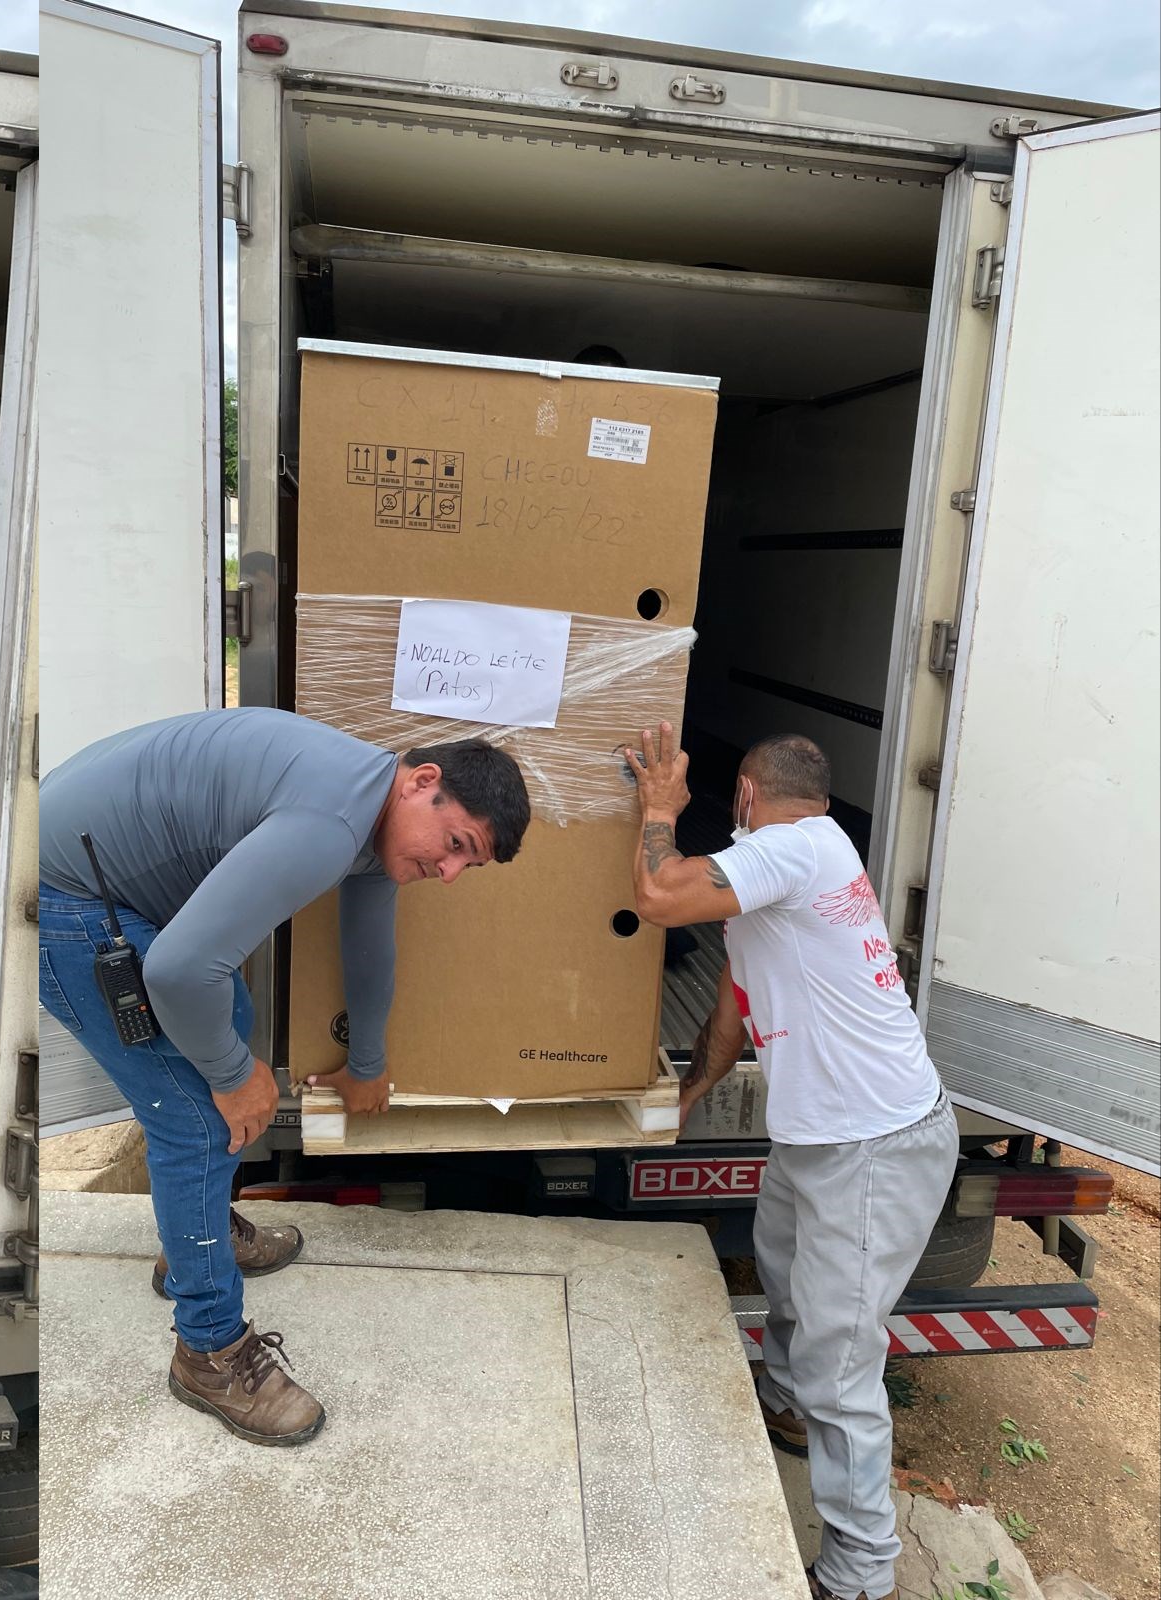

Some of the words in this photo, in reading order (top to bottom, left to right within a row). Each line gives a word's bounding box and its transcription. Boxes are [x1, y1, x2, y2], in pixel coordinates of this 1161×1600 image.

[481, 455, 592, 487] CHEGOU
[476, 496, 633, 547] 18/05/22
[411, 643, 480, 667] NOALDO
[519, 1048, 536, 1060] GE
[539, 1049, 608, 1063] Healthcare
[547, 1181, 588, 1191] BOXER
[640, 1166, 766, 1192] BOXE
